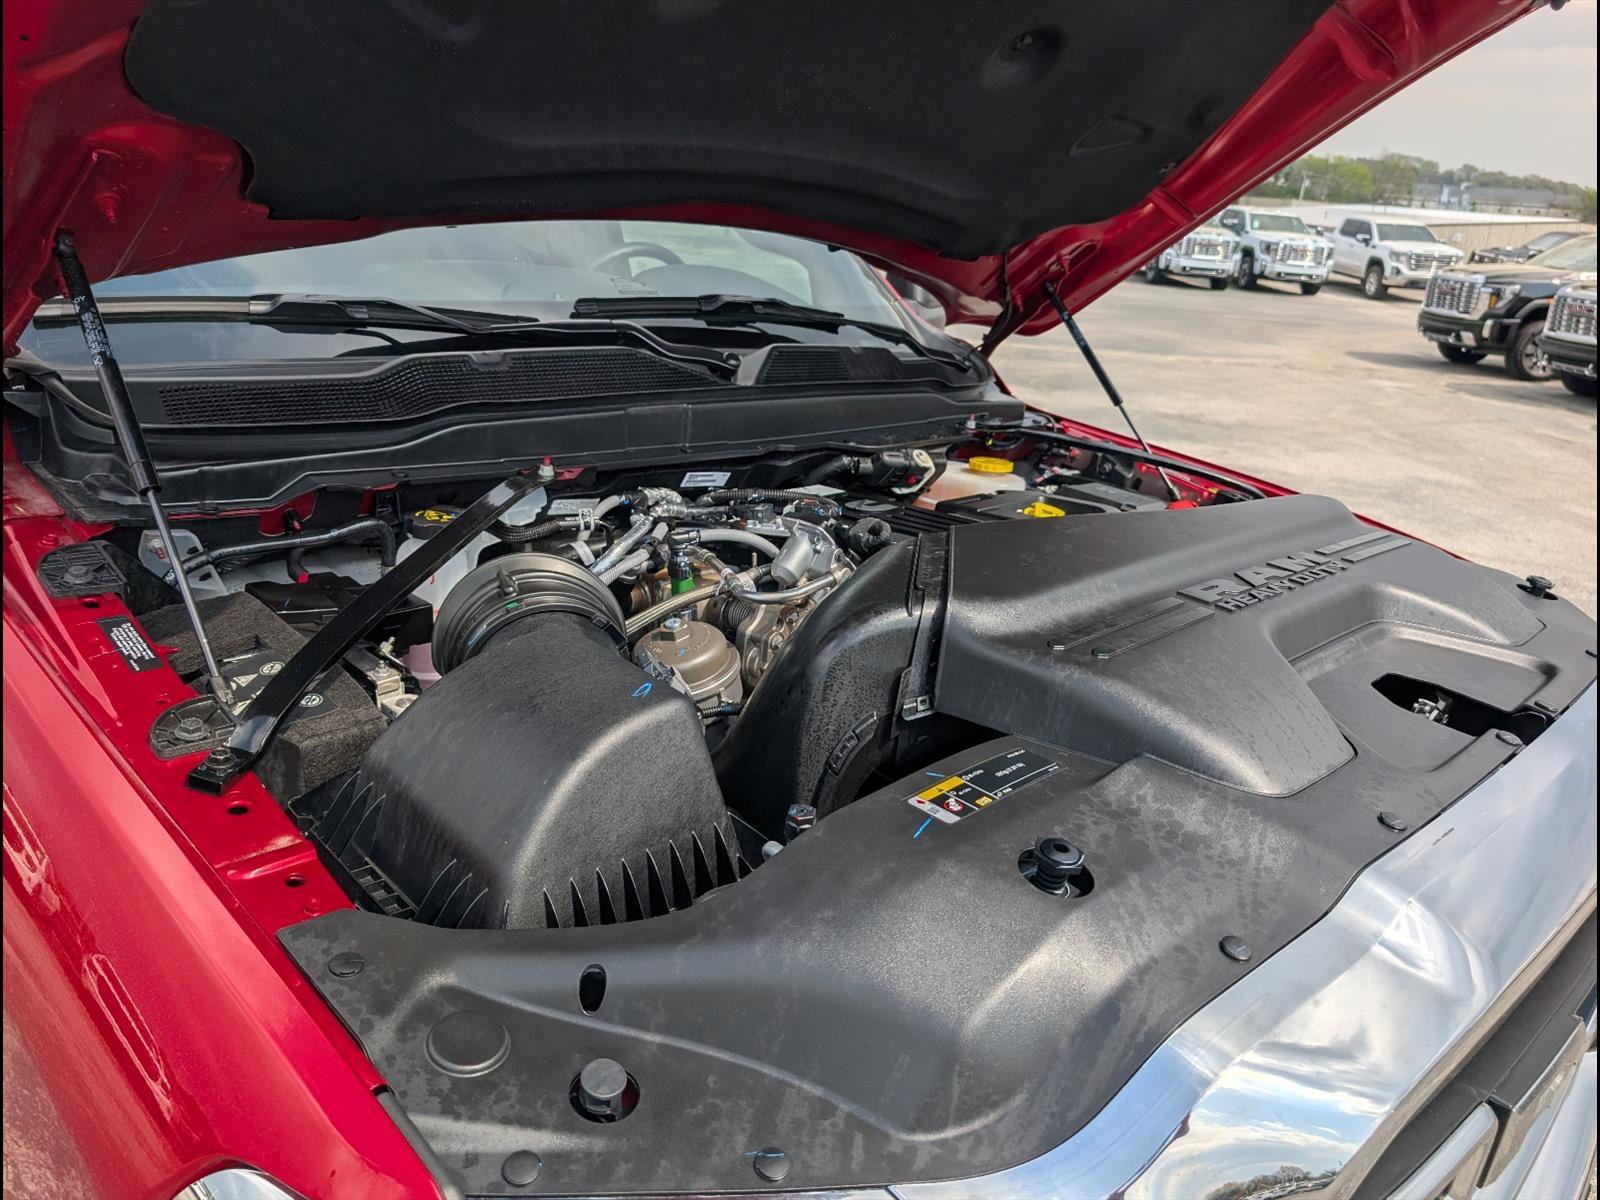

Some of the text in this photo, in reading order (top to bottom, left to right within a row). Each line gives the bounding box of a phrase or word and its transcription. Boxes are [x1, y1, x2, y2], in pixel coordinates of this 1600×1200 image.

[1176, 551, 1332, 605] RAM
[1214, 561, 1349, 614] HEAVY DUTY
